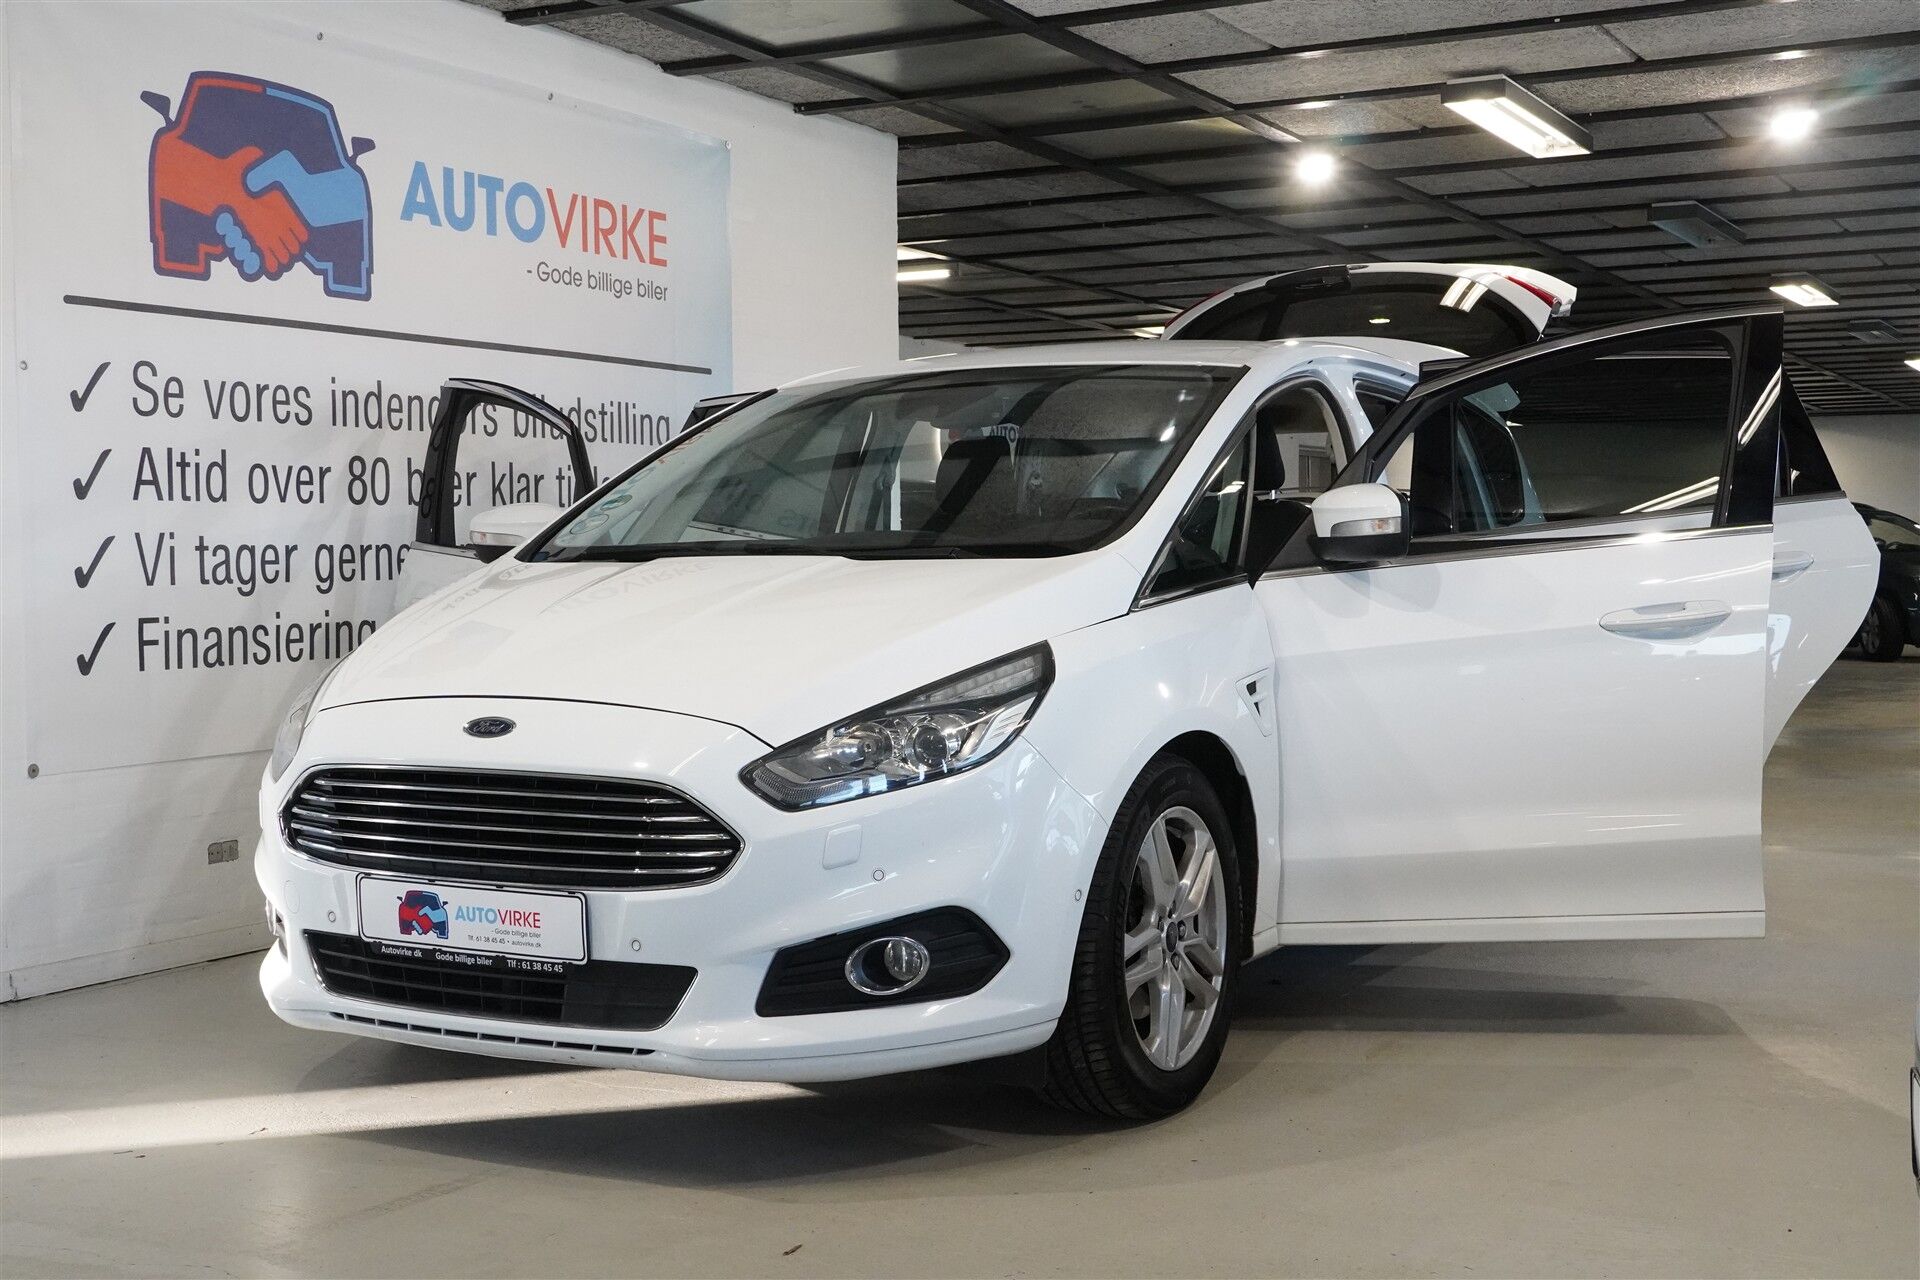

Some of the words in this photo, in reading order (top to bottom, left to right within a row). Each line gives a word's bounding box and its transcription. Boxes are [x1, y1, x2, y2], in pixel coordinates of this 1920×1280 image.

[400, 160, 667, 267] AUTOVIRKE
[537, 261, 583, 288] Gode
[588, 269, 632, 299] billige
[637, 279, 668, 301] biler
[132, 360, 184, 418] Se
[203, 379, 313, 426] vores
[331, 376, 498, 437] indenrs
[132, 447, 228, 503] Altid
[248, 463, 331, 504] over
[348, 455, 390, 506] 80
[407, 457, 477, 506] ber
[491, 461, 544, 507] klar
[134, 532, 176, 586] Vi
[195, 536, 298, 596] tager
[455, 905, 541, 929] AUTOVIRKE
[495, 928, 511, 936] Gode
[511, 930, 528, 938] billige
[529, 931, 541, 939] biler
[435, 951, 453, 962] Gode
[455, 953, 475, 965] billige
[476, 956, 493, 966] biler
[522, 961, 531, 969] 61
[532, 962, 542, 971] 38
[543, 963, 552, 972] 45
[554, 964, 563, 973] 45
